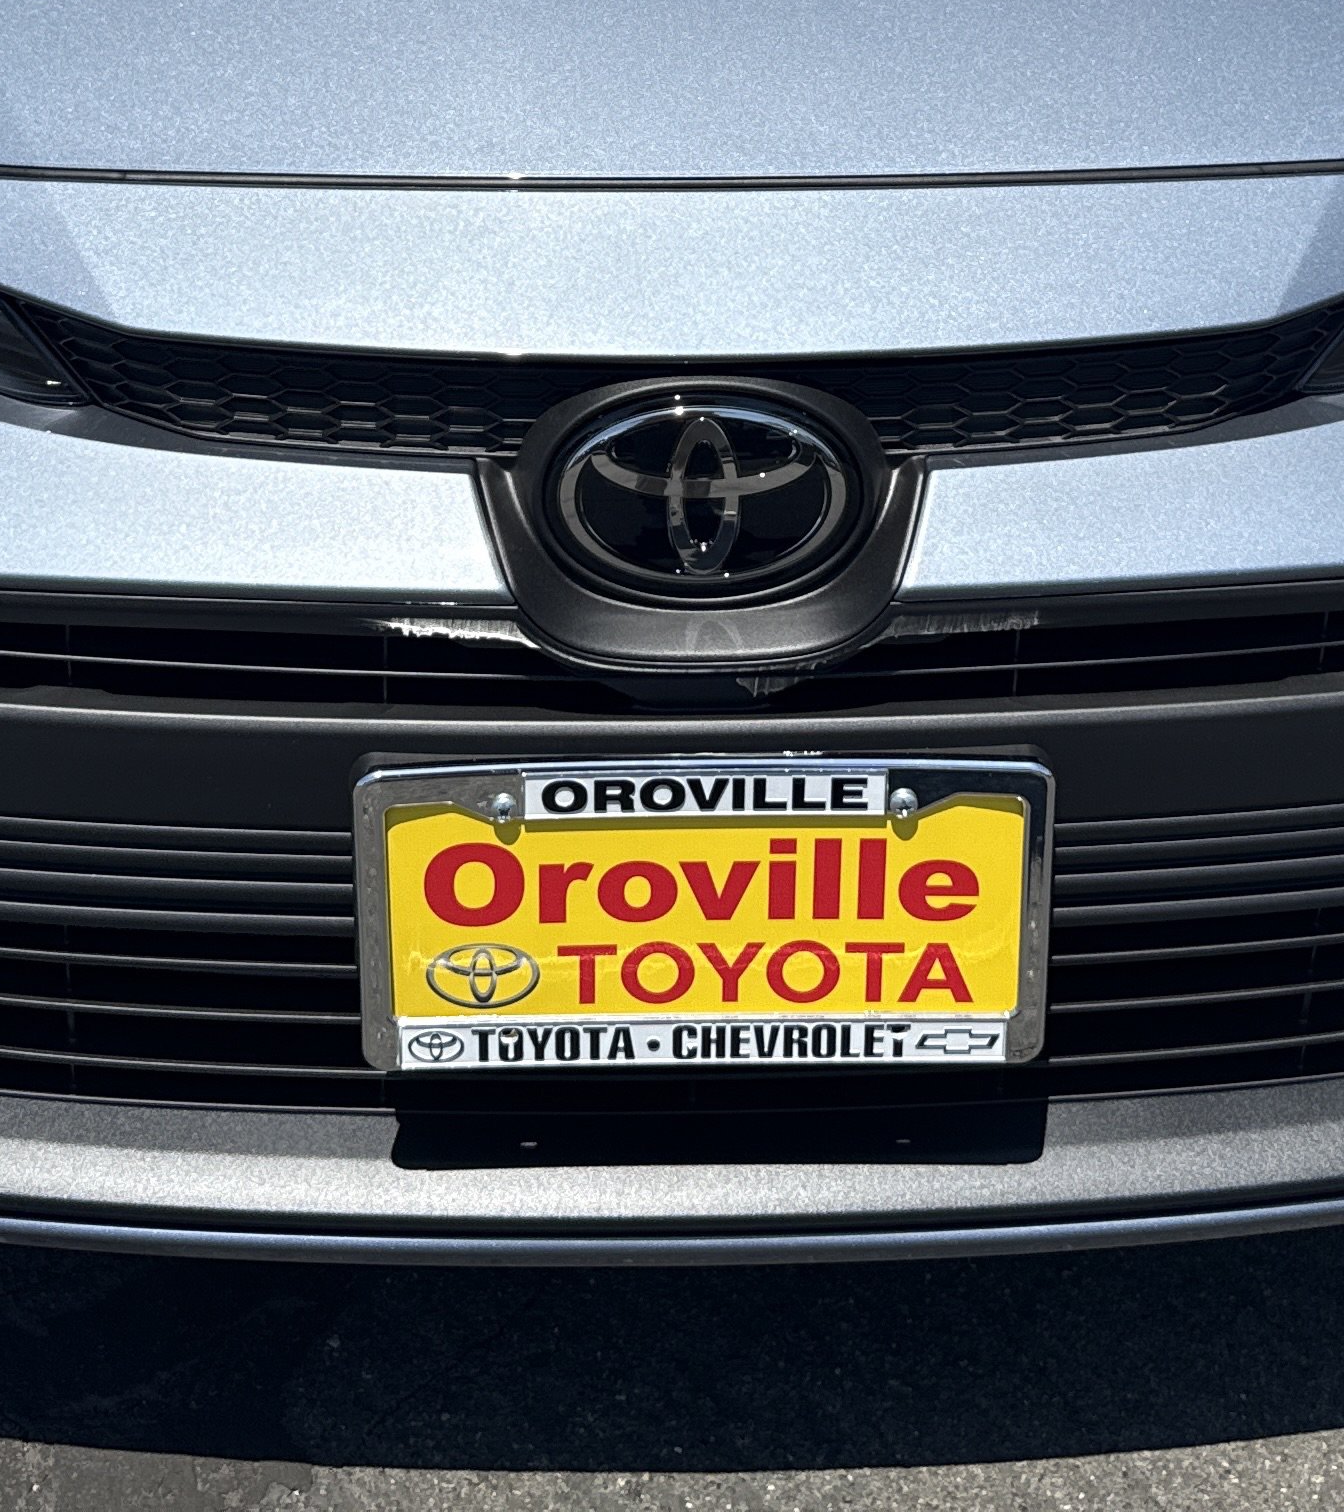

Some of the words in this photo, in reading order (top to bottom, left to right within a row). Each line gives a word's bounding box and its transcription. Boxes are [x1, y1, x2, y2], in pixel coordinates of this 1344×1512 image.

[542, 777, 869, 814] OROVILLE
[424, 838, 980, 927] Oroville
[558, 940, 974, 1004] TOYOTA
[471, 1025, 636, 1062] TOYOTA
[672, 1023, 912, 1060] CHEVROLET
